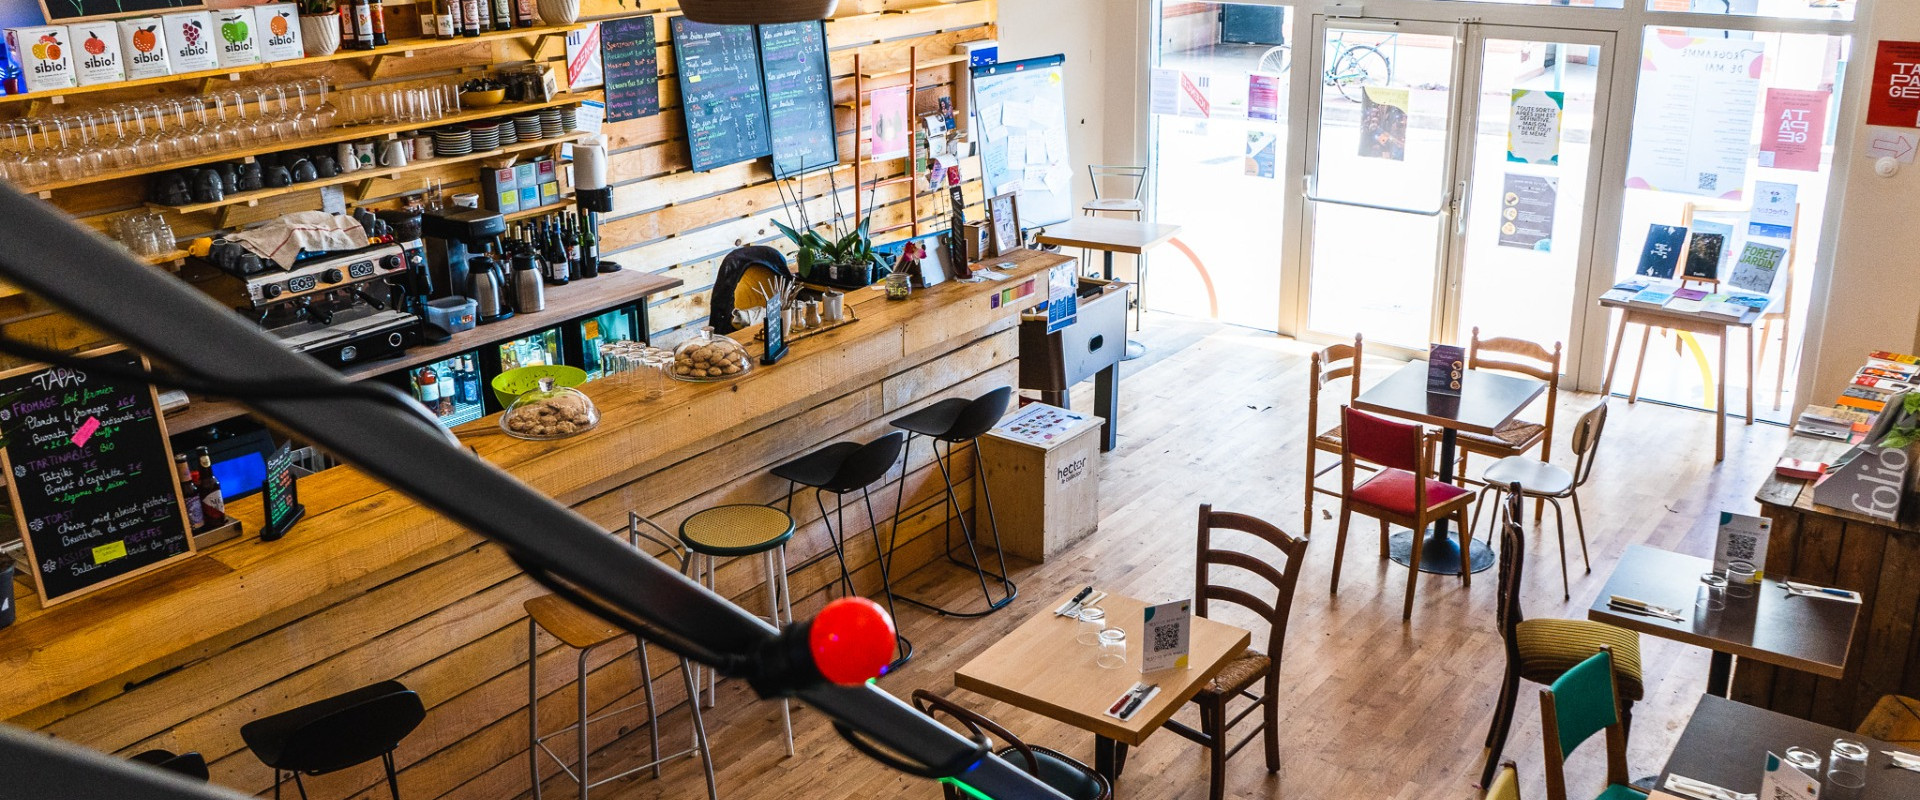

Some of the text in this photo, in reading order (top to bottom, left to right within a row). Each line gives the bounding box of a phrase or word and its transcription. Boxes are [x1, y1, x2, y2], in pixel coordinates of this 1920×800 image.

[225, 38, 252, 52] sibio!
[268, 32, 295, 46] sibio!
[134, 48, 164, 64] sibio!
[180, 42, 208, 57] sibio!
[34, 57, 66, 74] sibio!
[84, 52, 115, 68] sibio!
[1888, 85, 1920, 99] GE
[1739, 255, 1776, 270] JARDIN
[31, 368, 87, 391] TAPAS
[12, 396, 59, 418] FROMAGE
[25, 414, 59, 430] Planche
[73, 403, 109, 425] fromages
[1057, 457, 1086, 480] hector
[1851, 447, 1908, 522] folio
